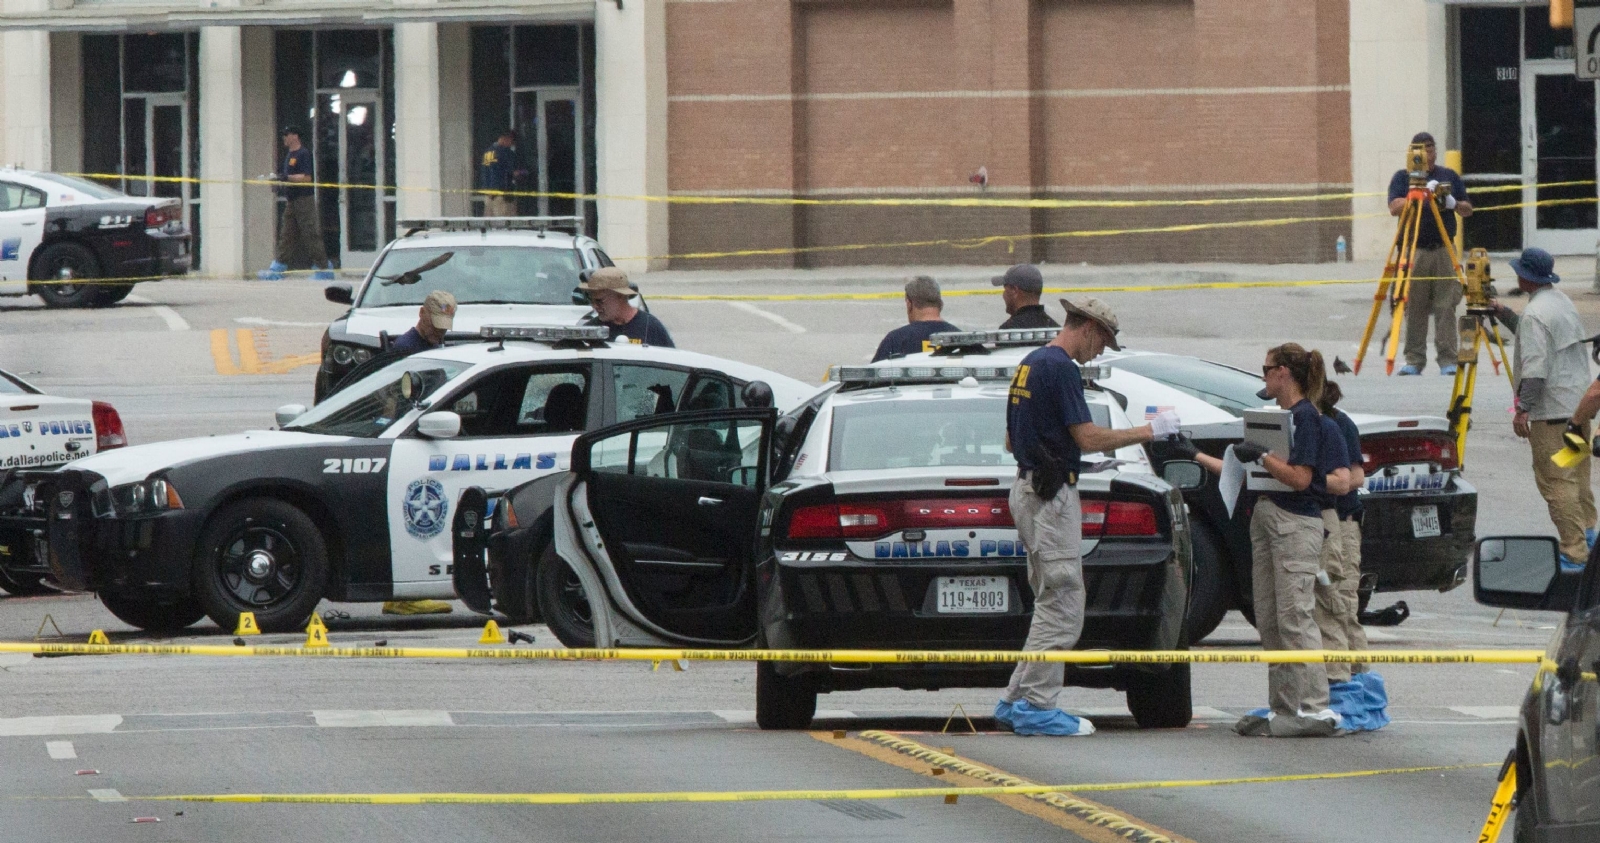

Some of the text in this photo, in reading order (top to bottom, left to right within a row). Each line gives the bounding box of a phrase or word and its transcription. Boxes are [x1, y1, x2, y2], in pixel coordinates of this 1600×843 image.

[39, 420, 93, 435] POLICE
[0, 450, 90, 467] .dallaspolice.net
[428, 452, 557, 471] DALLAS
[323, 458, 387, 474] 2107
[1368, 473, 1443, 491] DALLAS POLICE
[874, 540, 970, 558] DALLAS
[780, 552, 847, 561] 3156
[959, 579, 987, 587] TEXAS
[244, 616, 252, 629] 2
[313, 629, 321, 641] 4
[729, 652, 764, 660] POLICIA
[1156, 654, 1190, 663] POLICIA
[1323, 655, 1352, 663] CRUZA
[1370, 655, 1406, 663] POLICIA
[1408, 655, 1420, 663] LA
[1464, 655, 1474, 663] LA
